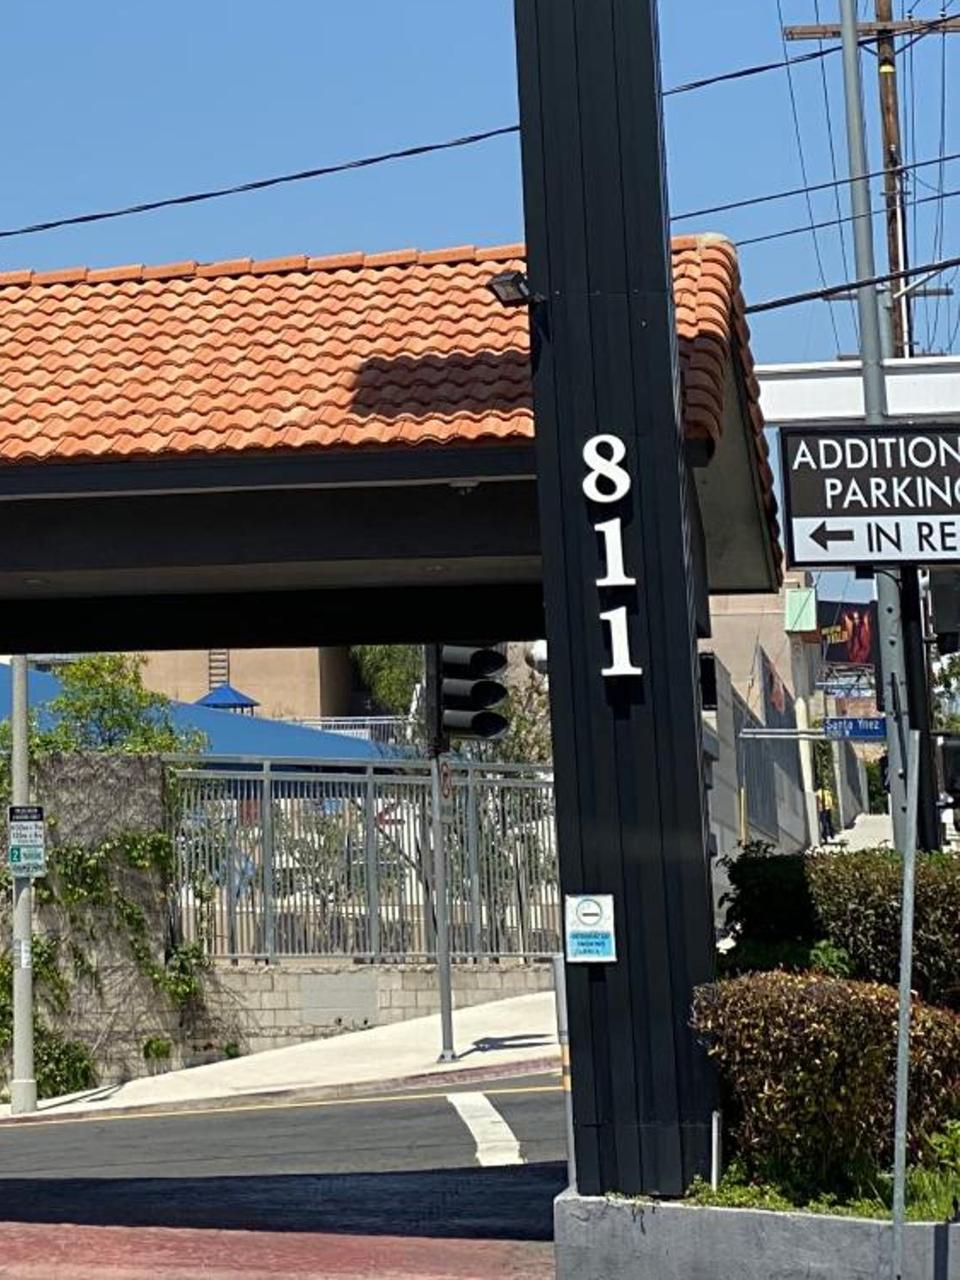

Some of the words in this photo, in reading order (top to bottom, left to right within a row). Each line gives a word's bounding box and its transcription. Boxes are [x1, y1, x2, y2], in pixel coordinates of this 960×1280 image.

[825, 475, 960, 509] PARKIN
[867, 522, 902, 552] IN
[582, 433, 643, 676] 811
